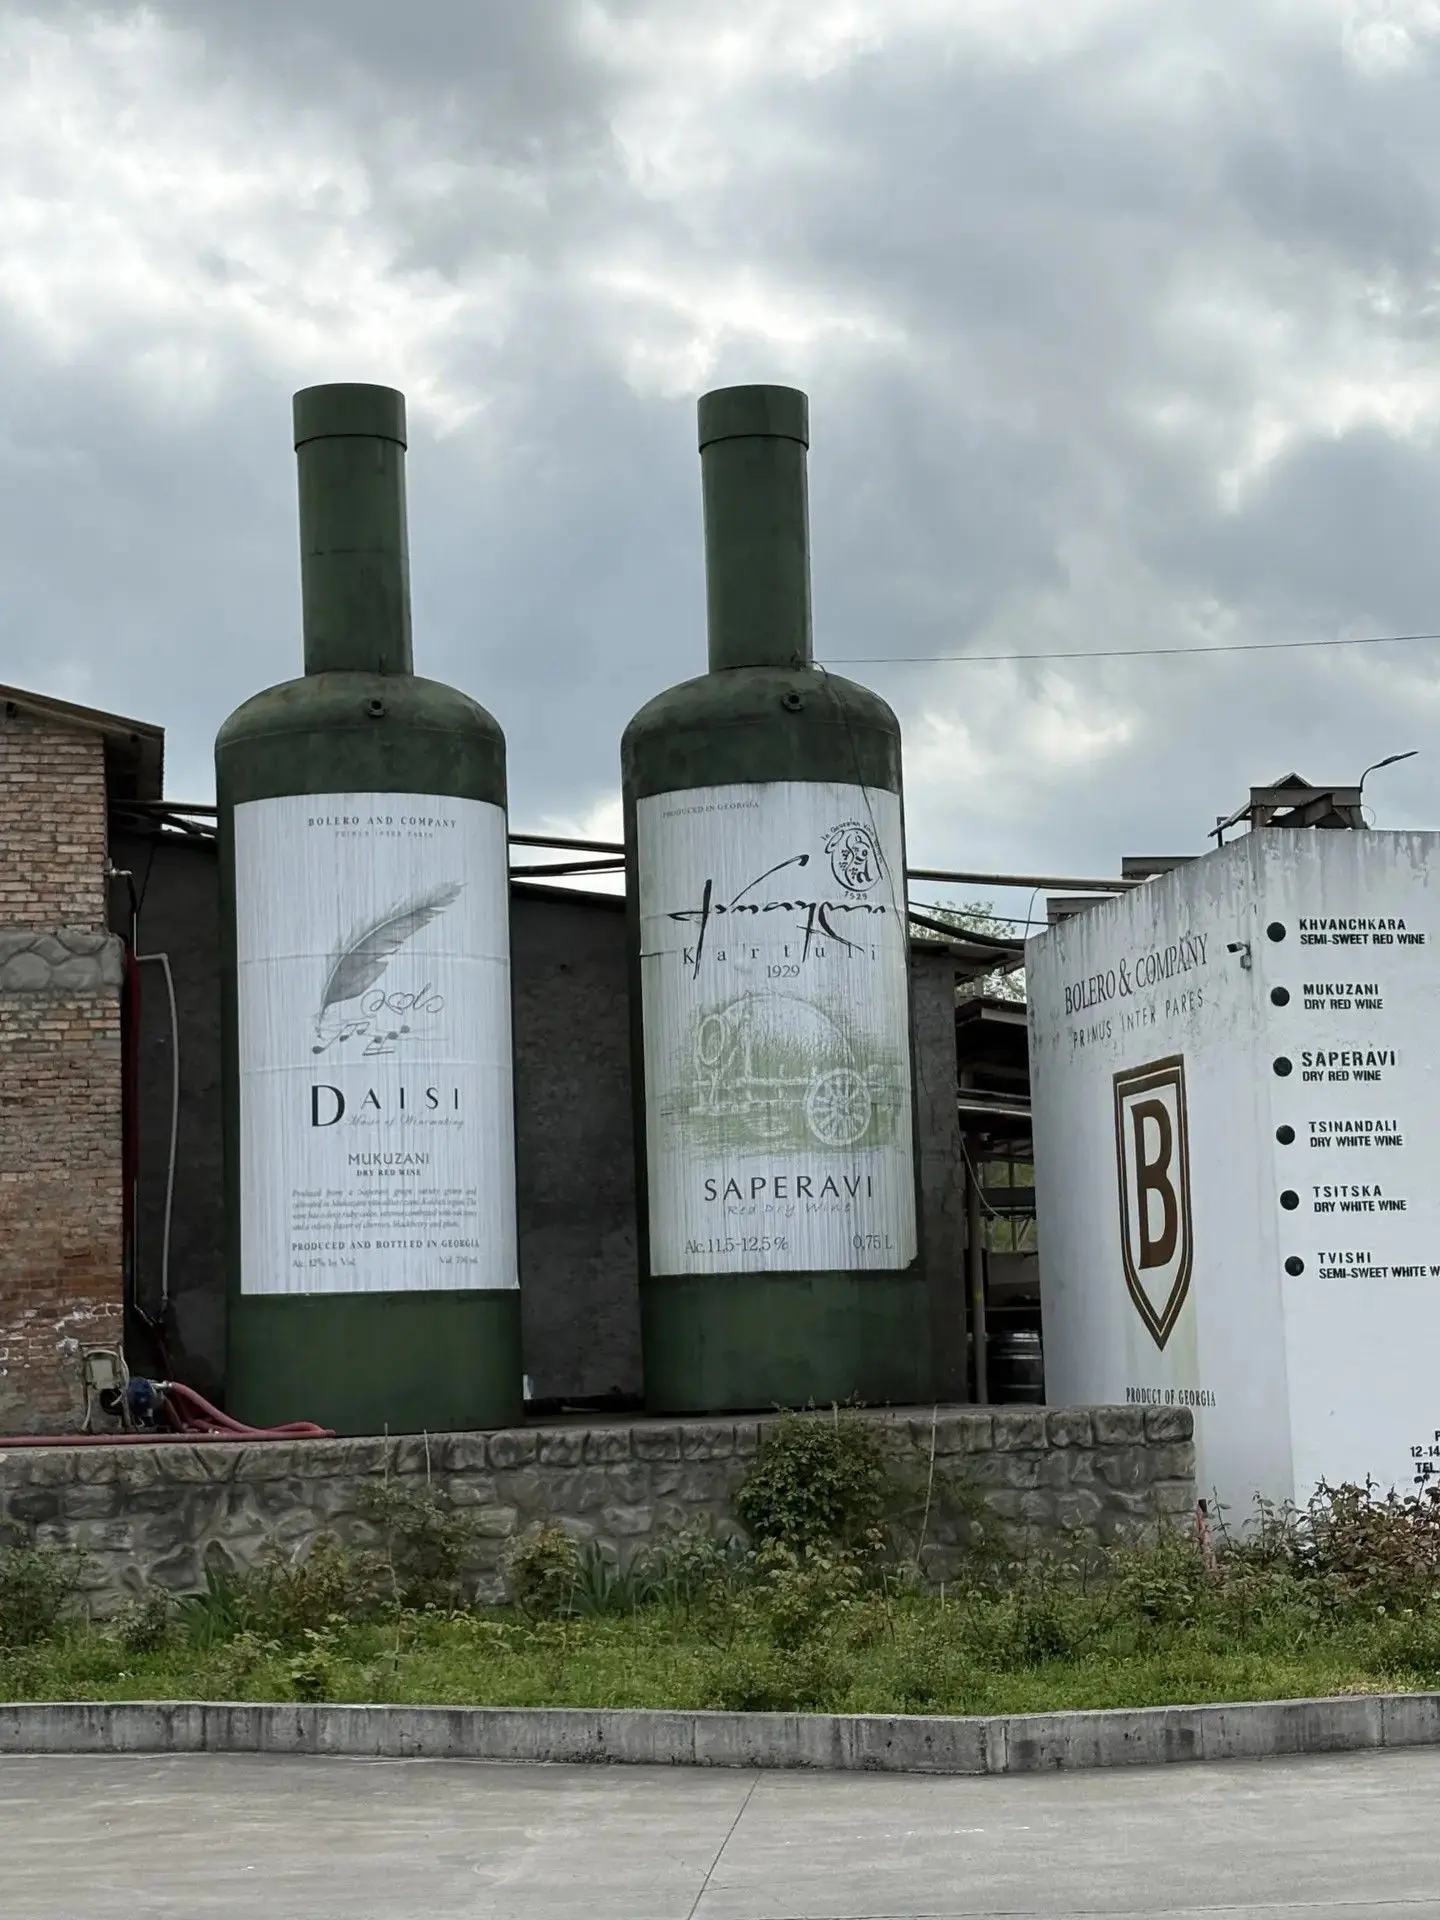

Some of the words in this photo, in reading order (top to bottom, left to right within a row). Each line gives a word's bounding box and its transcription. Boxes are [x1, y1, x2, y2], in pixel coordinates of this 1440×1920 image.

[717, 802, 759, 811] GEORGIA
[308, 816, 360, 827] BOLERO
[367, 816, 393, 826] AND
[400, 816, 457, 829] COMPANY
[1300, 918, 1407, 931] KHVANCHKARA
[1300, 933, 1369, 945] SEMI-SWEET
[1372, 933, 1394, 945] RED
[1397, 933, 1426, 945] WINE
[767, 964, 801, 979] 1929
[1064, 969, 1116, 1016] BOLERO
[1118, 958, 1133, 997] &
[1135, 932, 1208, 988] COMPANY
[1303, 983, 1379, 996] MUKUZANI
[1304, 999, 1326, 1010] DRY
[1330, 998, 1351, 1010] RED
[1355, 998, 1384, 1010] WINE
[1073, 1020, 1112, 1049] PRIMUS
[1121, 1006, 1156, 1032] INTER
[1165, 989, 1204, 1019] PARES
[1301, 1050, 1395, 1067] SAPERAVI
[1302, 1070, 1324, 1082] DRY
[1328, 1070, 1349, 1081] RED
[1352, 1070, 1381, 1081] WINE
[311, 1084, 459, 1127] DAISI
[1308, 1119, 1397, 1133] TSINANDALI
[1310, 1136, 1332, 1148] DRY
[1335, 1135, 1371, 1147] WHITE
[1374, 1134, 1403, 1146] WINE
[348, 1153, 429, 1165] MUKUZANI
[356, 1169, 374, 1177] DRY
[378, 1168, 396, 1177] RED
[399, 1168, 421, 1177] WINE
[704, 1175, 872, 1201] SAPERAVI
[1130, 1098, 1178, 1270] B
[1312, 1184, 1383, 1198] TSITSKA
[1314, 1202, 1336, 1213] DRY
[1339, 1201, 1375, 1212] WHITE
[1378, 1200, 1407, 1211] WINE
[292, 1241, 345, 1252] PRODUCED
[350, 1240, 371, 1250] AND
[376, 1239, 422, 1250] BOTTLED
[427, 1239, 438, 1249] IN
[441, 1239, 480, 1249] GEORGIA
[1318, 1252, 1372, 1265] TVISHI
[1318, 1267, 1389, 1279] SEMI-SWEET
[1391, 1266, 1427, 1278] WHITE
[1126, 1386, 1161, 1405] PRODUCT
[1165, 1389, 1175, 1405] OF
[1178, 1389, 1216, 1407] GEORGIA
